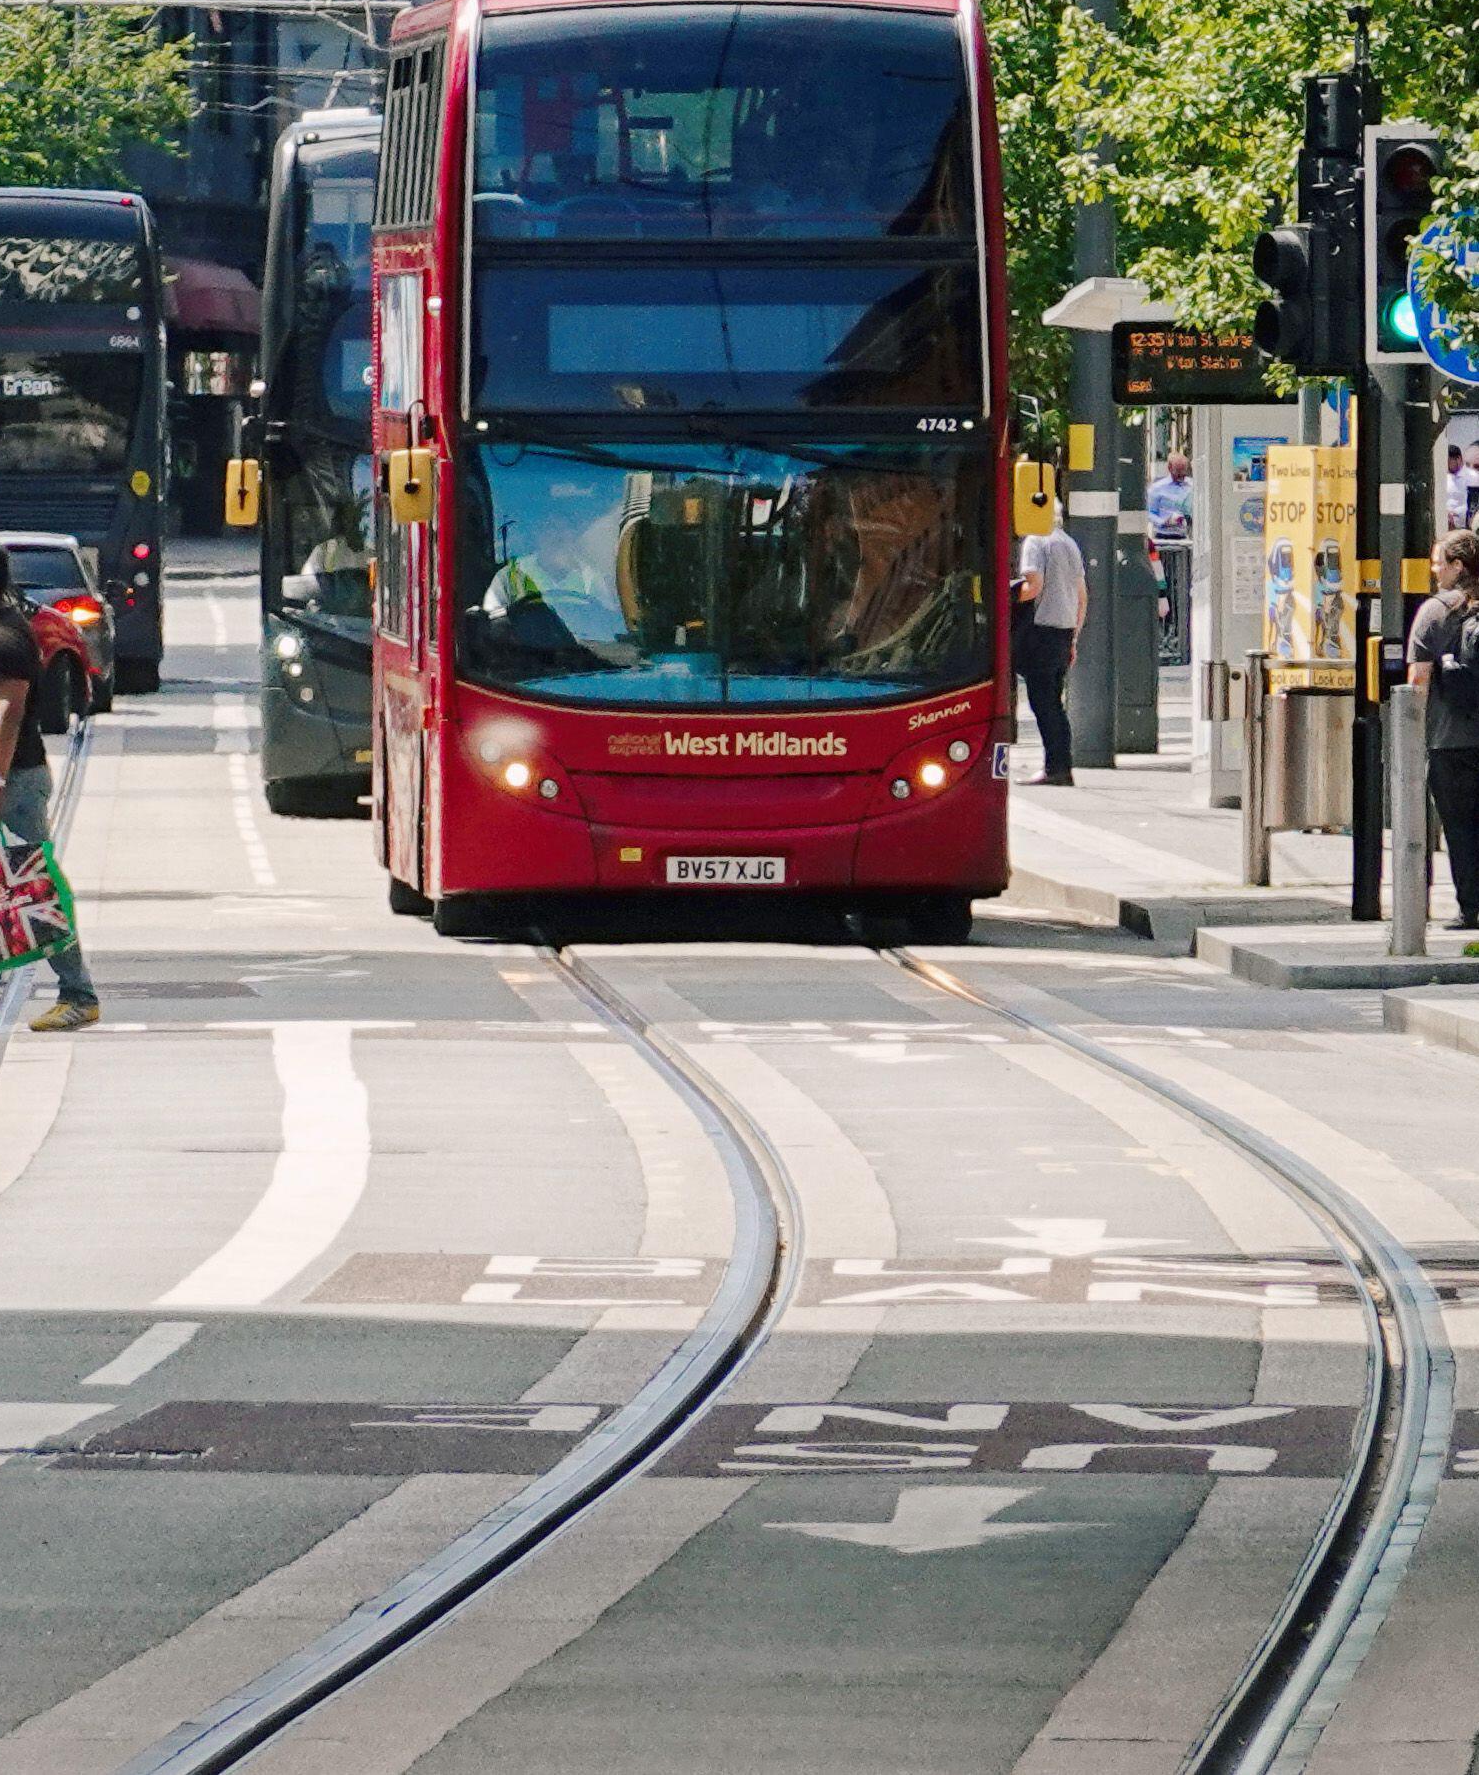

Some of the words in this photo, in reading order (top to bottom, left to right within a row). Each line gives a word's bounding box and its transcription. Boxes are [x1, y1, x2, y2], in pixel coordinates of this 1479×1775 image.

[3, 375, 54, 396] Green
[916, 417, 957, 433] 4742
[1270, 463, 1289, 477] Two
[1290, 464, 1311, 477] Lines
[1268, 501, 1307, 524] STOP
[1315, 503, 1357, 526] STOP
[1269, 670, 1286, 686] ook
[1313, 670, 1333, 686] Look
[907, 700, 972, 731] Shannon
[665, 730, 730, 757] West
[736, 731, 848, 758] Midlands
[676, 860, 731, 881] BV57
[735, 860, 776, 881] XJG
